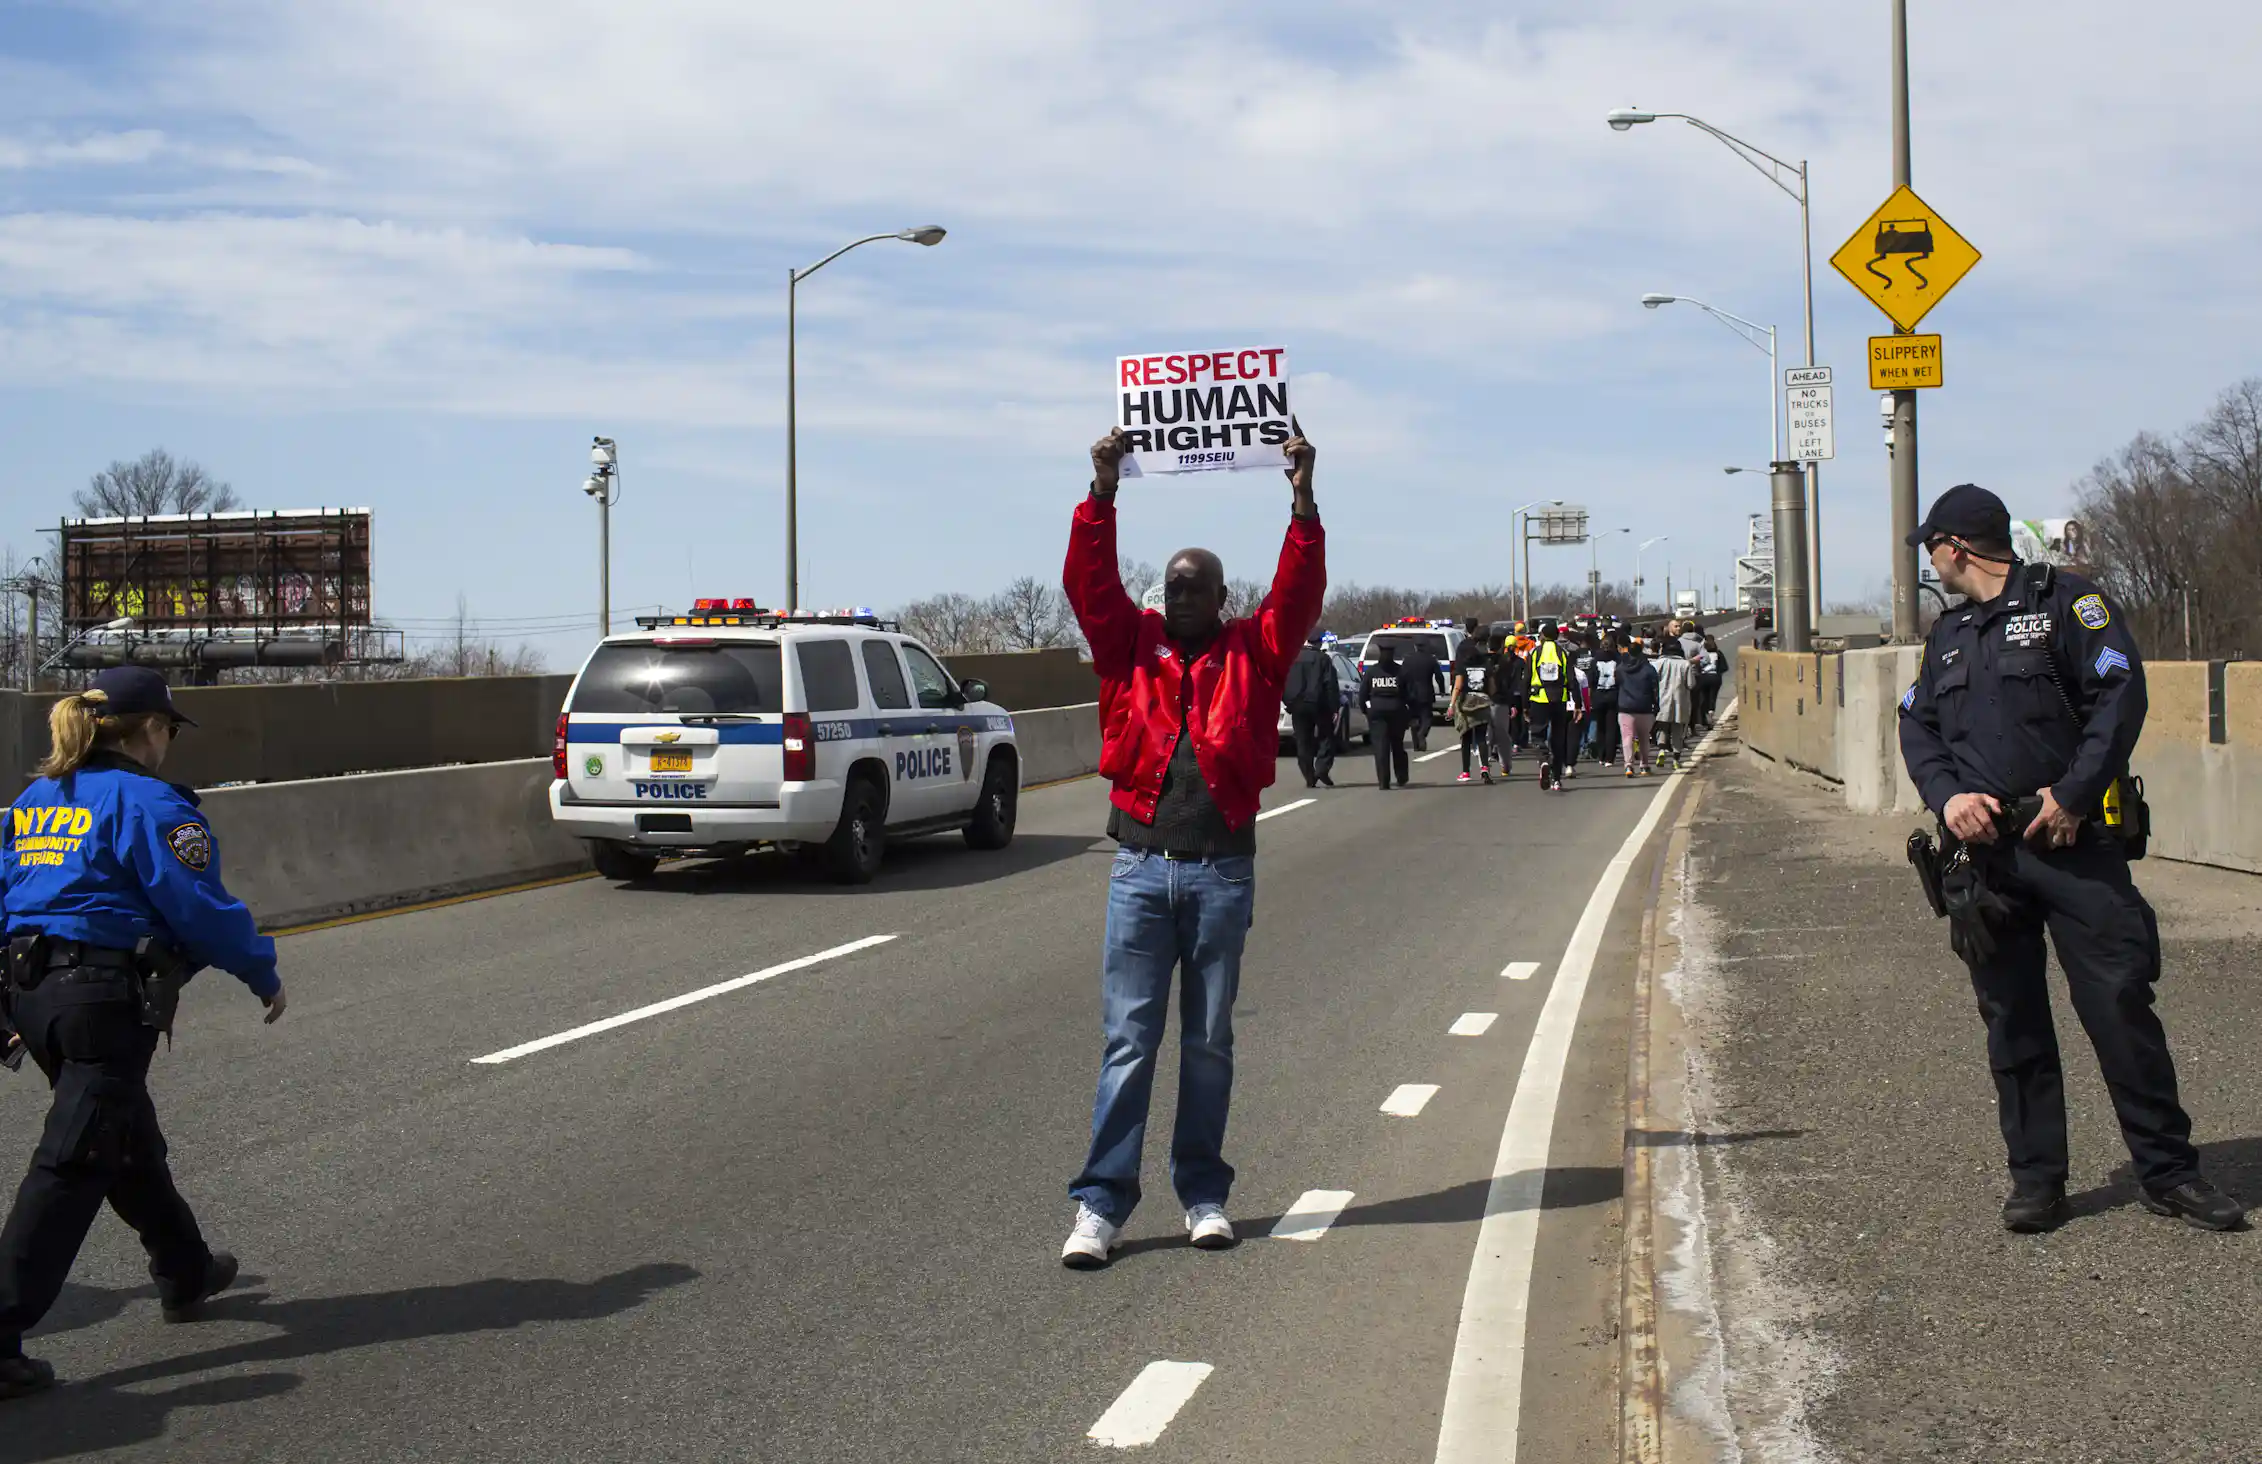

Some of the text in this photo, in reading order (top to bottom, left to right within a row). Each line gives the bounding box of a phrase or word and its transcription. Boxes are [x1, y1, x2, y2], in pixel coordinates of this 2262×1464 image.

[1874, 345, 1936, 360] SLIPPERY
[1121, 348, 1284, 387] RESPECT
[1880, 366, 1932, 378] WHEN WET
[1792, 371, 1826, 381] AHEAD
[1801, 390, 1816, 398] NO
[1123, 382, 1288, 426] HUMAN
[1791, 400, 1828, 409] TRUCKS
[1794, 419, 1826, 428] BUSES
[1125, 421, 1290, 453] RIGHTS
[1800, 438, 1821, 447] LEFT
[1178, 452, 1234, 464] 1199SEIU
[1799, 449, 1823, 458] LANE
[2005, 619, 2051, 635] POLICE
[1372, 677, 1397, 688] POLICE
[817, 722, 852, 740] 57250
[896, 748, 951, 781] POLICE
[636, 783, 706, 799] POLICE
[13, 806, 93, 836] NYPD
